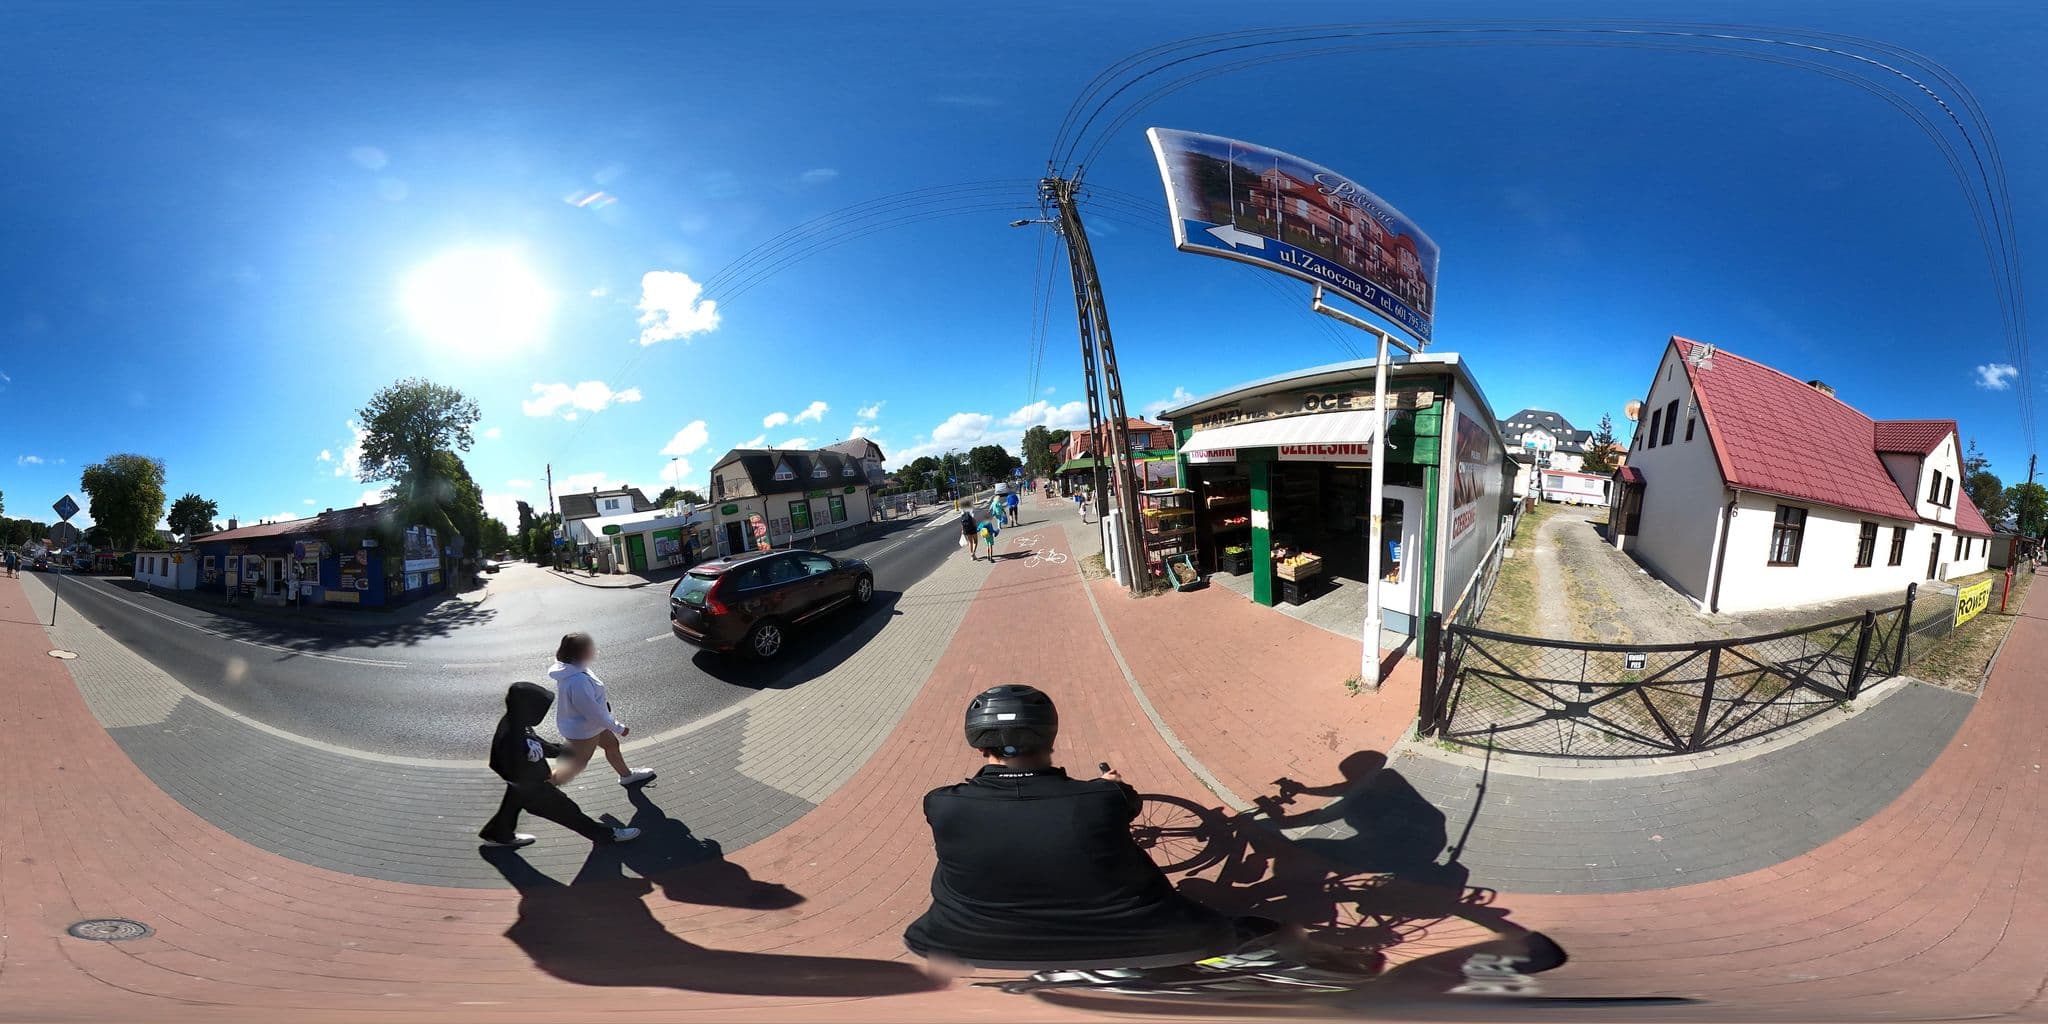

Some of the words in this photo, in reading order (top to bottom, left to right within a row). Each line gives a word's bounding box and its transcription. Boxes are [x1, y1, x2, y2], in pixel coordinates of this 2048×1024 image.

[1364, 285, 1376, 299] 27
[1380, 296, 1393, 312] tel.
[1394, 305, 1407, 321] 601
